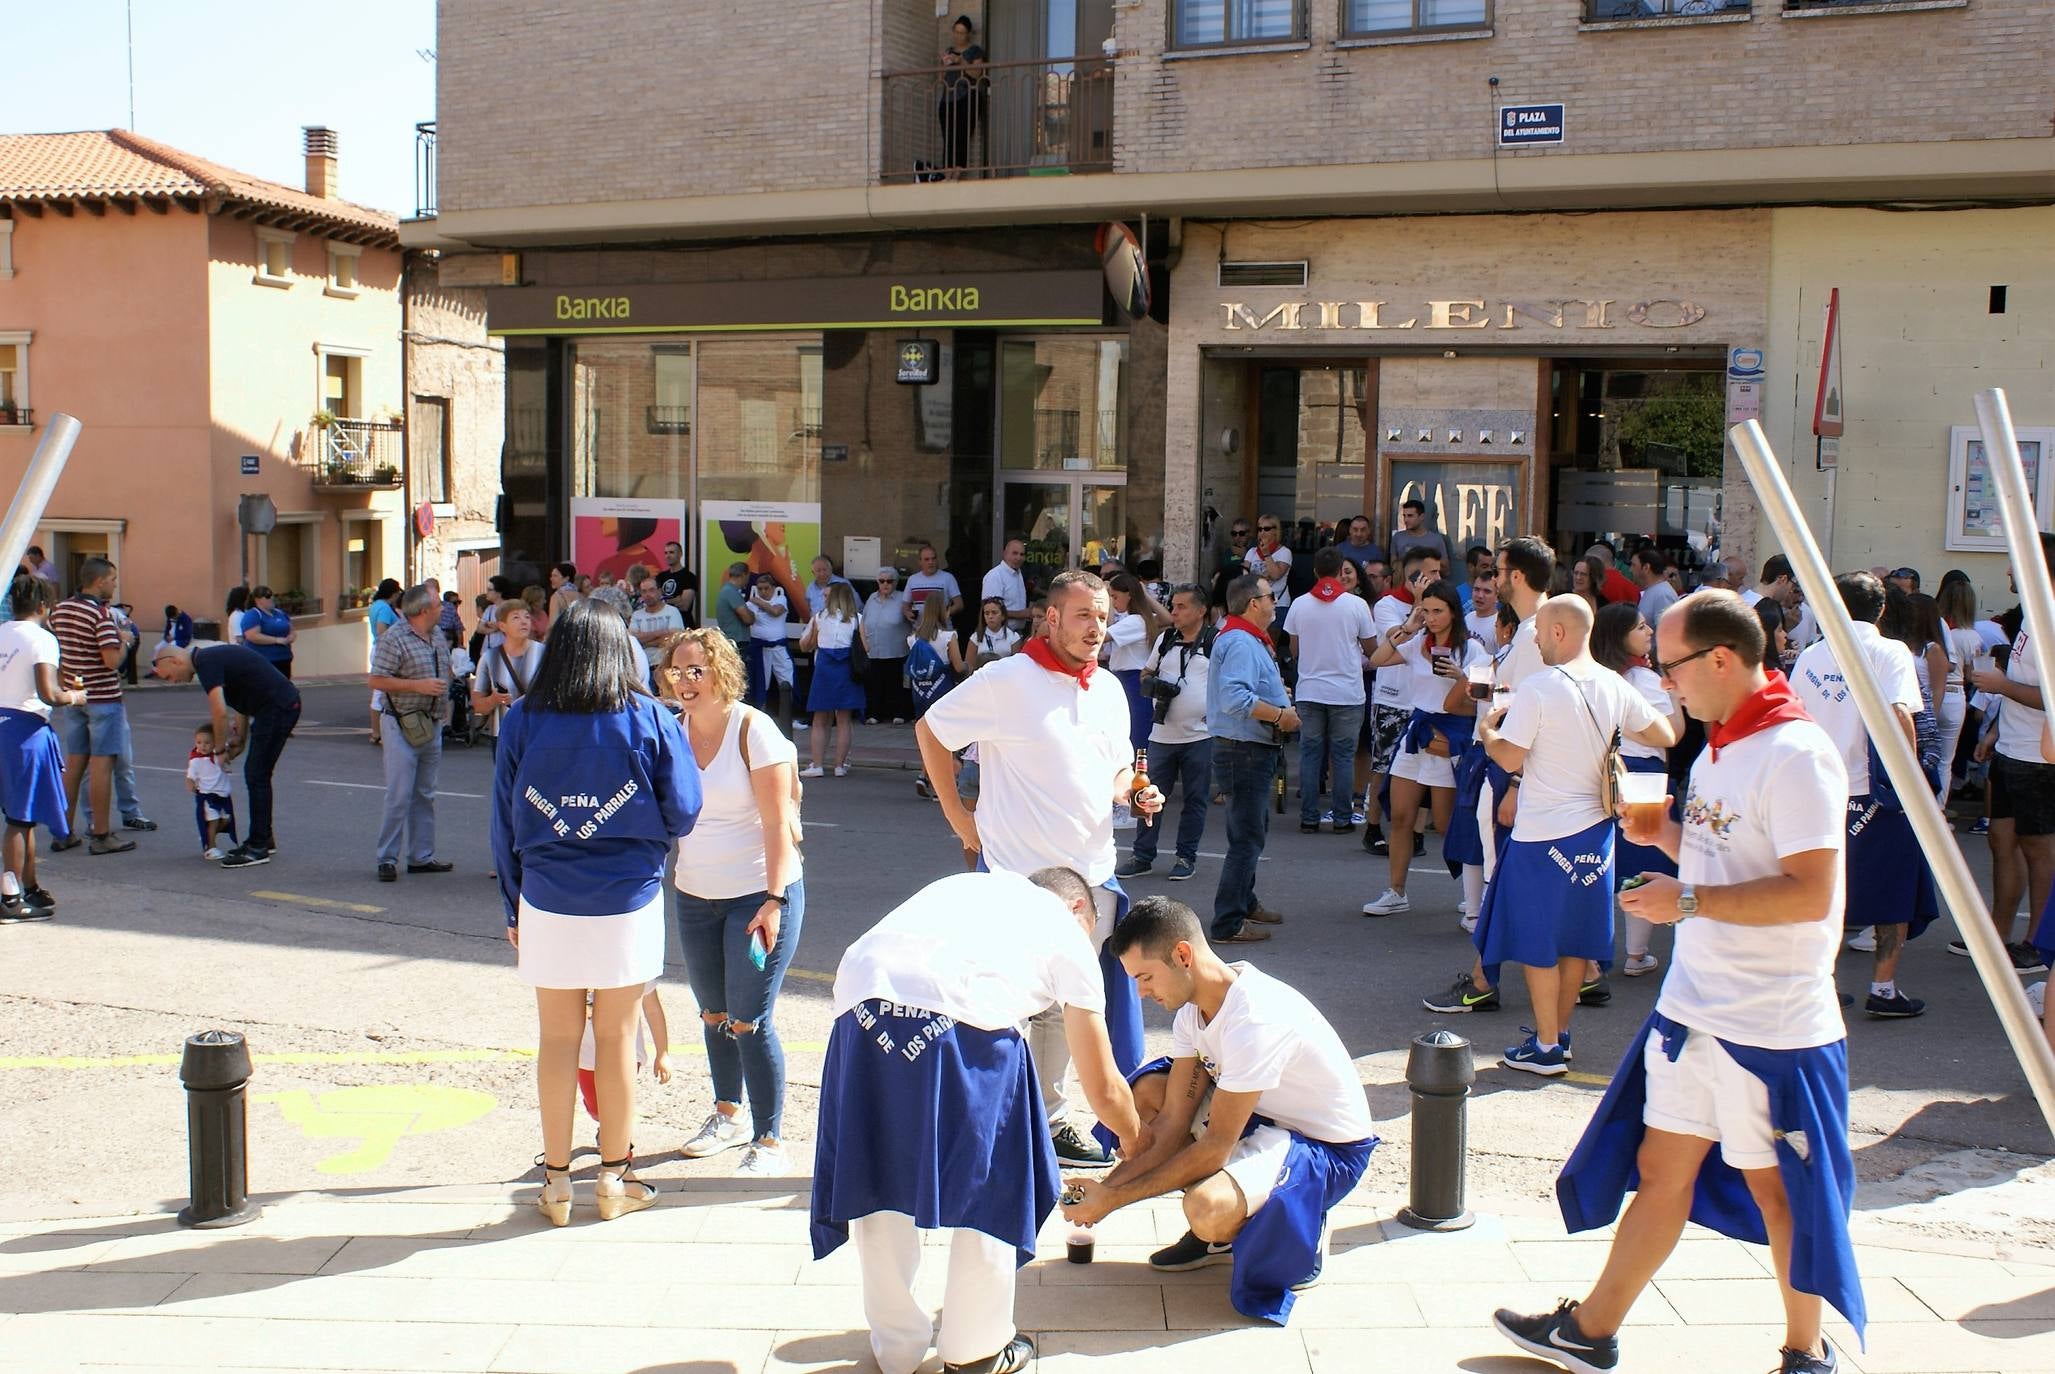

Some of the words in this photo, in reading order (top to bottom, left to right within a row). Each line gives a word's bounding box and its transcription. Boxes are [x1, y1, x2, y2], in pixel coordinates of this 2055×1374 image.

[1519, 111, 1546, 123] PLAZA
[1503, 129, 1514, 137] DEL
[1515, 126, 1560, 136] AYUNTAMIENTO
[556, 295, 630, 320] Bankia
[889, 285, 979, 311] Bankia
[1220, 299, 1705, 330] MILENIO
[524, 785, 559, 820] VIRGEN
[552, 818, 571, 837] DE
[576, 820, 598, 840] LOS
[593, 779, 638, 825] PARRALES
[560, 792, 600, 808] PEÑA
[1848, 821, 1864, 836] LOS
[1547, 846, 1574, 874] VIRGEN
[1581, 872, 1598, 887] LOS
[1574, 852, 1602, 864] PEÑA
[876, 1030, 895, 1054] DE
[901, 1035, 926, 1062] LOS
